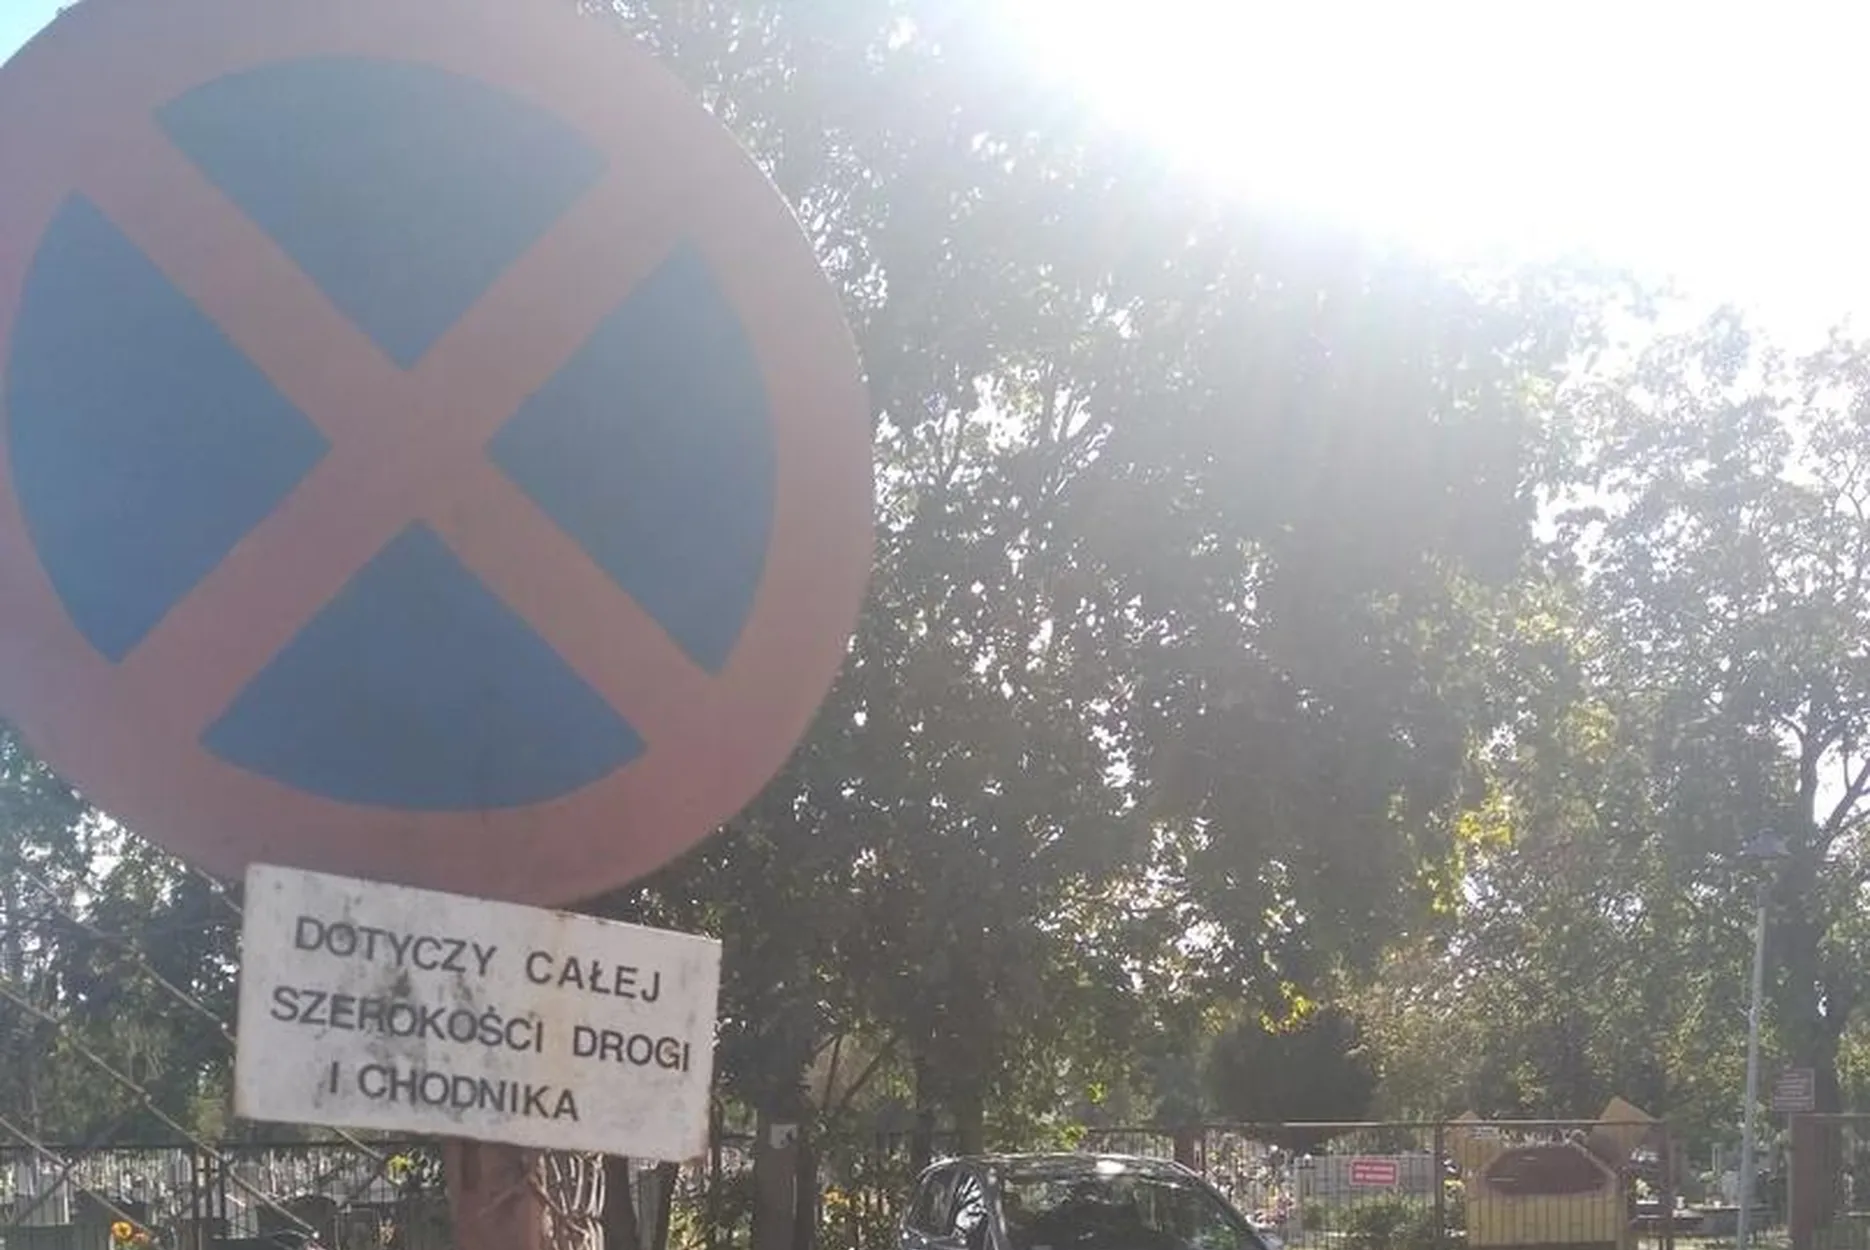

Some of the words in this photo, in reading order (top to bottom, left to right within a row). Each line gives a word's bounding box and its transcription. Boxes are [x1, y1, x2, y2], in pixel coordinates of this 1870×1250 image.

[295, 916, 497, 976] DOTYCZY
[526, 951, 661, 1004] CAŁEJ
[270, 986, 544, 1053] SZEROKOŚCI
[572, 1025, 690, 1073] DROGI
[329, 1061, 339, 1094] I
[358, 1063, 580, 1122] CHODNIKA
